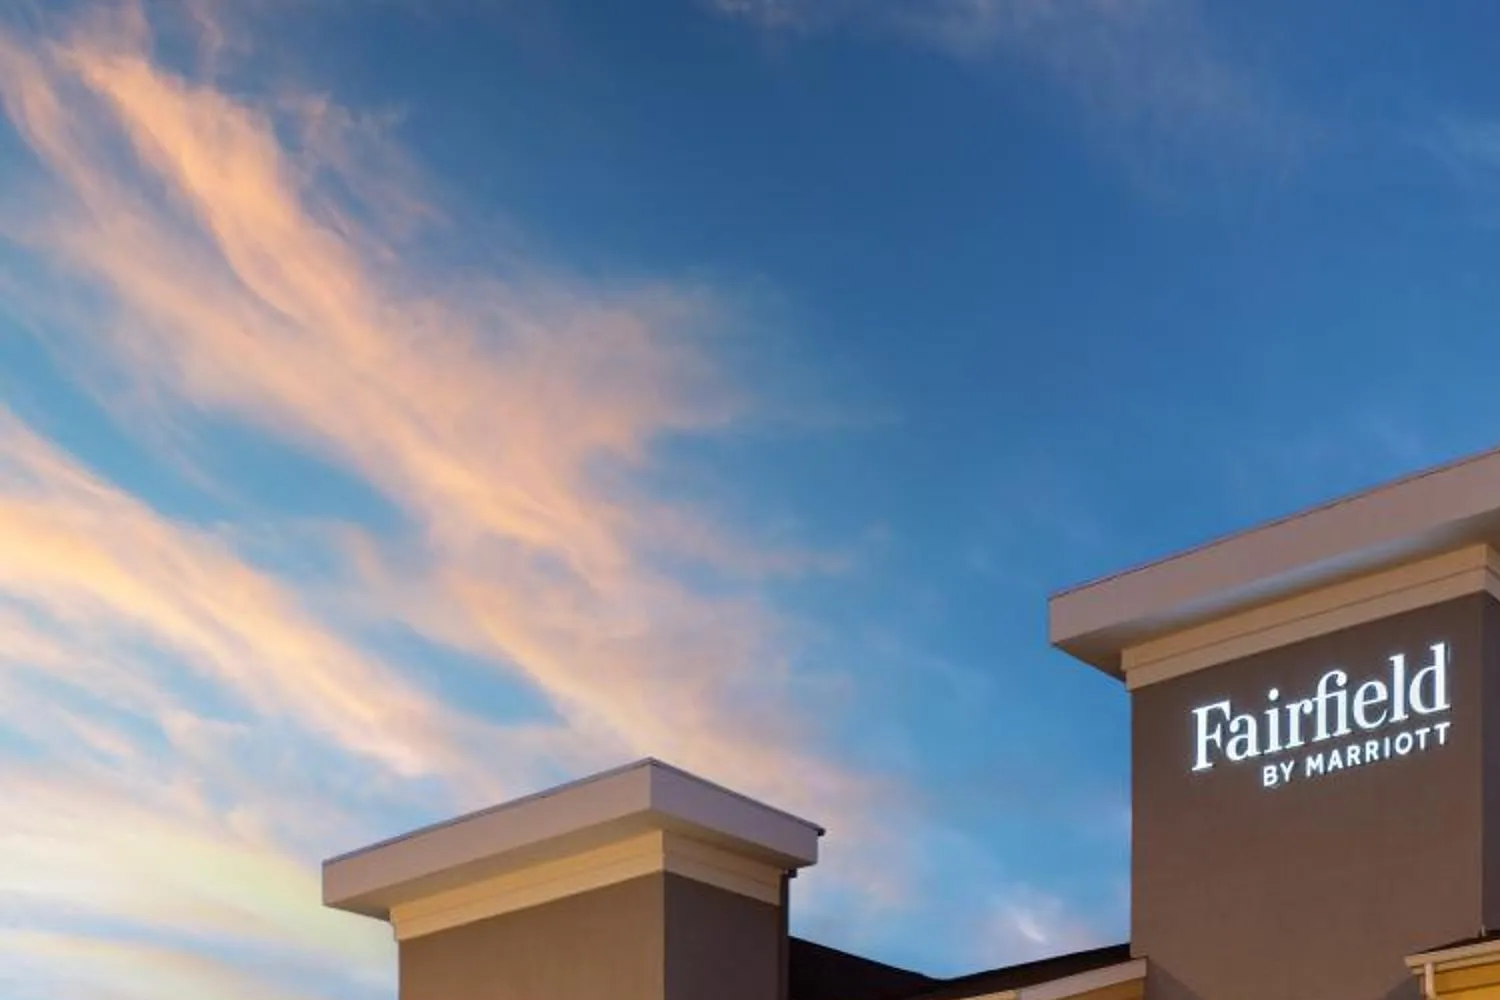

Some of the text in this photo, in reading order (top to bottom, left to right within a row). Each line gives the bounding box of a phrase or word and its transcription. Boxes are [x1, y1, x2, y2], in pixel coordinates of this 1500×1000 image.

[1191, 643, 1451, 771] Fairfield
[1263, 722, 1451, 787] BY MARRIOTT
